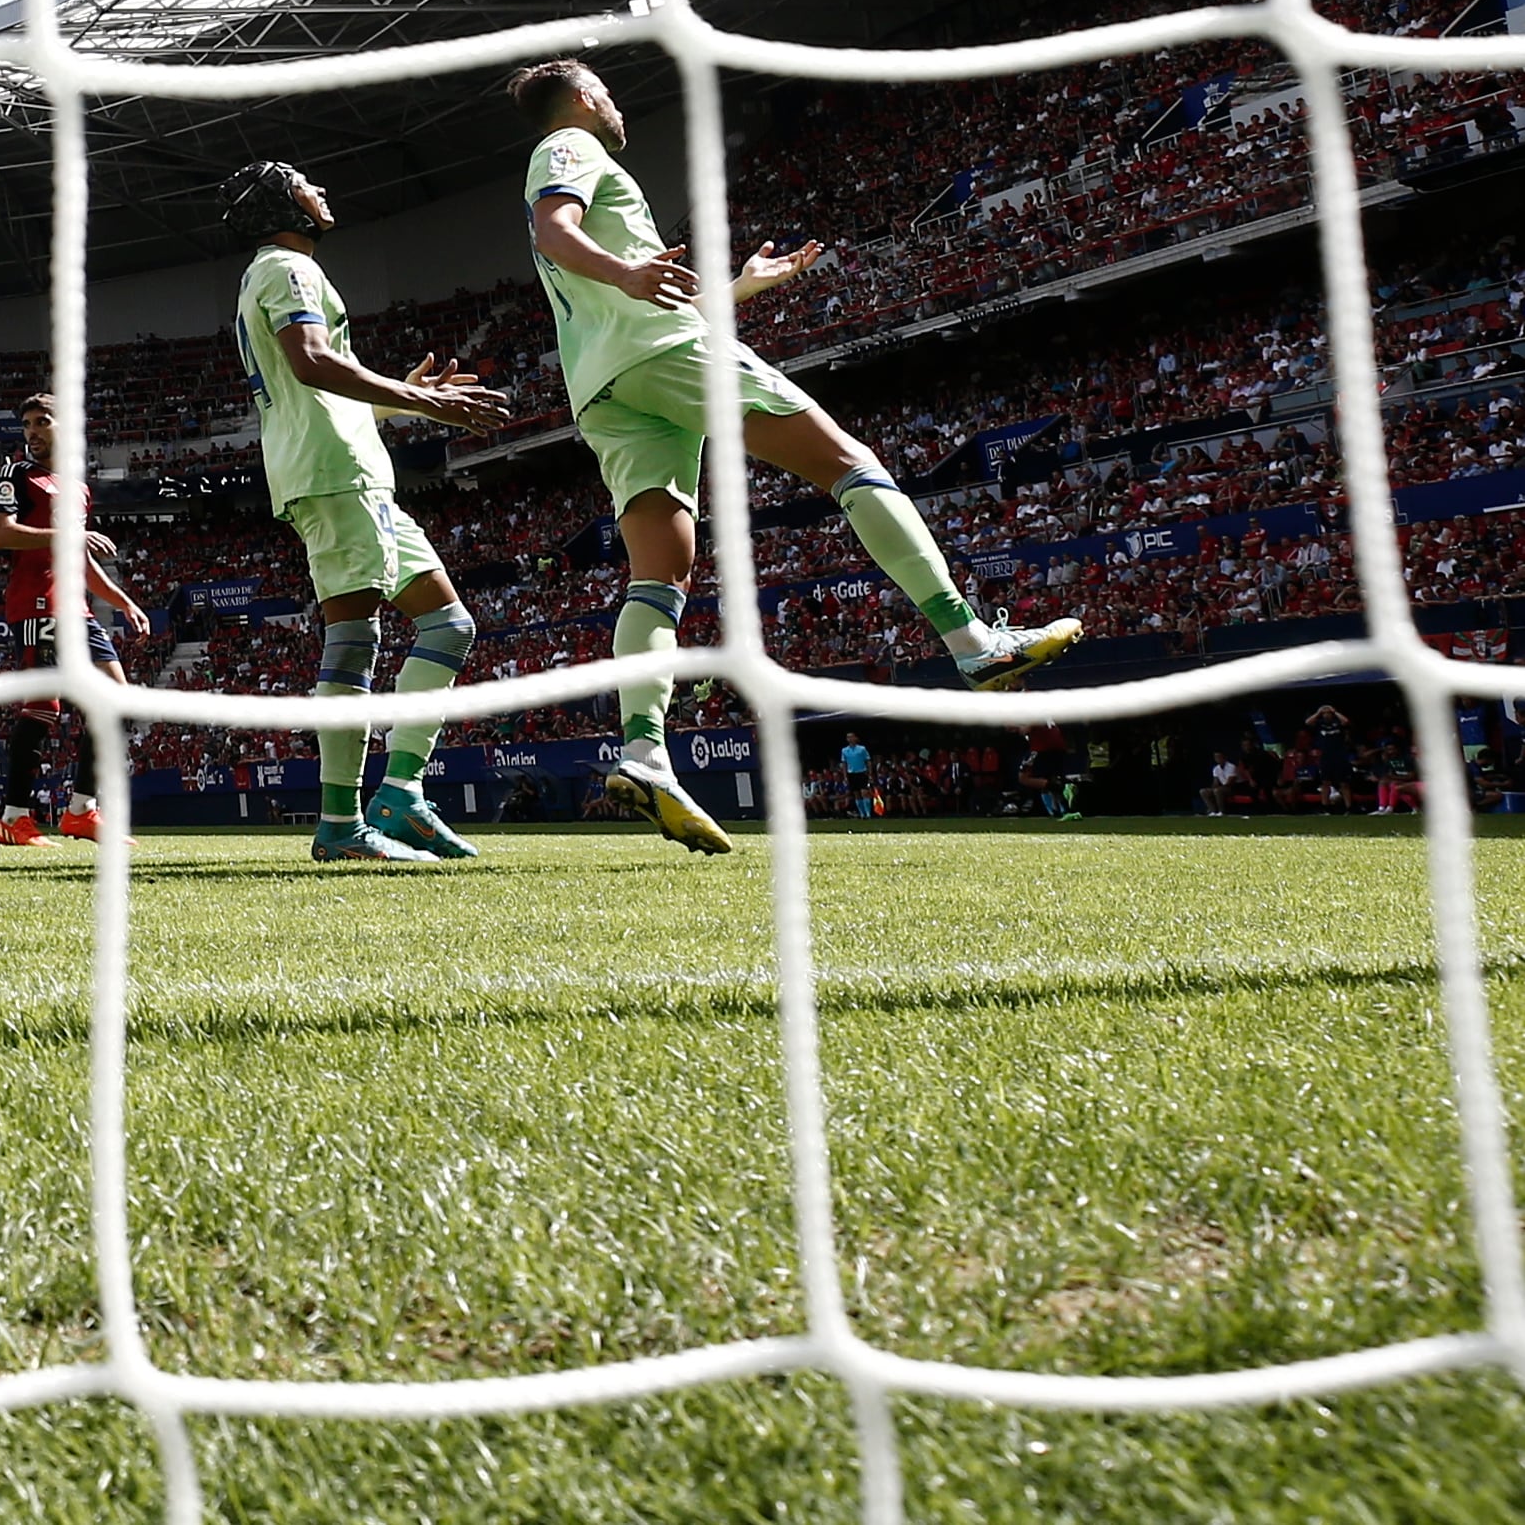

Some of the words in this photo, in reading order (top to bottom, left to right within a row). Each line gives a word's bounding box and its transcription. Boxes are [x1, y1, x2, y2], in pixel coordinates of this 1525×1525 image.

[211, 586, 241, 597] DIARIO
[242, 585, 253, 594] DE
[711, 738, 750, 761] LaLiga
